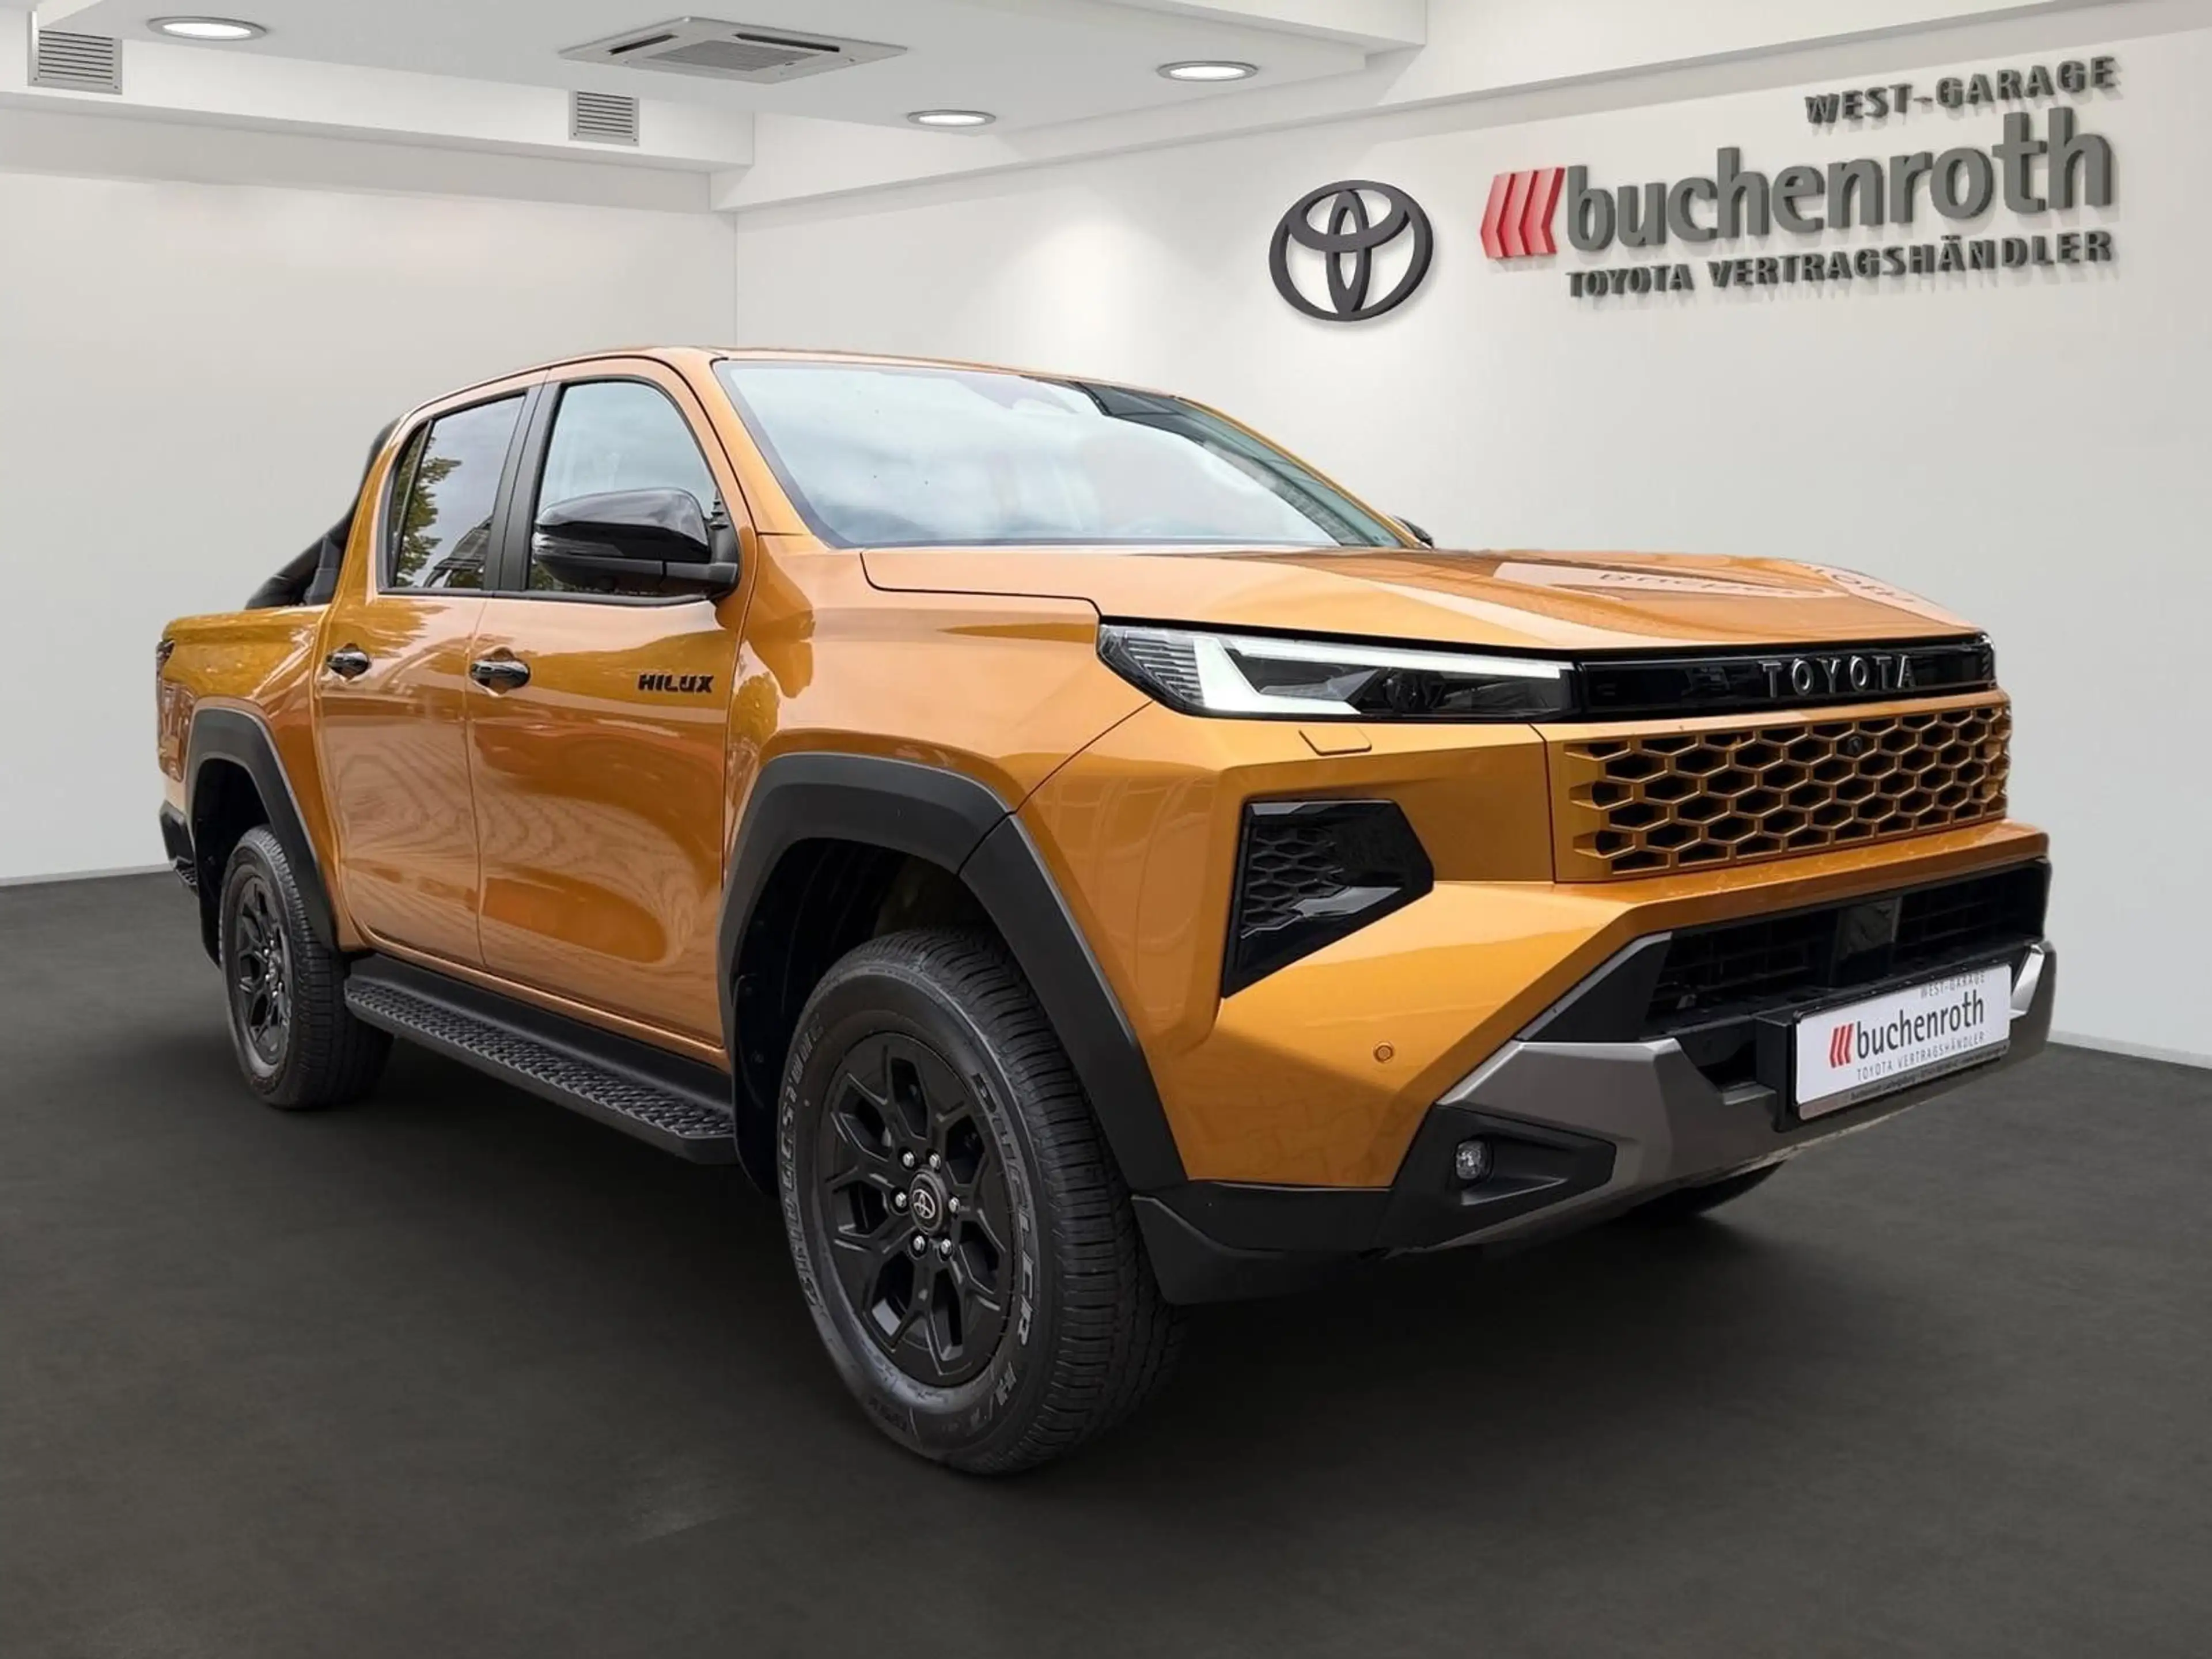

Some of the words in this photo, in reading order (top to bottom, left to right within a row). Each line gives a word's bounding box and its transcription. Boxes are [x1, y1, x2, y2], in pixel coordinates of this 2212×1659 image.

[1804, 56, 2115, 125] WEST-GARAGE
[1567, 107, 2112, 251] buchenroth
[1565, 263, 1695, 298] TOYOTA
[1707, 230, 2113, 289] VERTRAGSHÄNDLER
[638, 673, 714, 693] HILUX
[1758, 654, 1916, 699] TOYOTA
[1857, 989, 1984, 1059] buchenroth
[1857, 1060, 1893, 1081] TOYOTA
